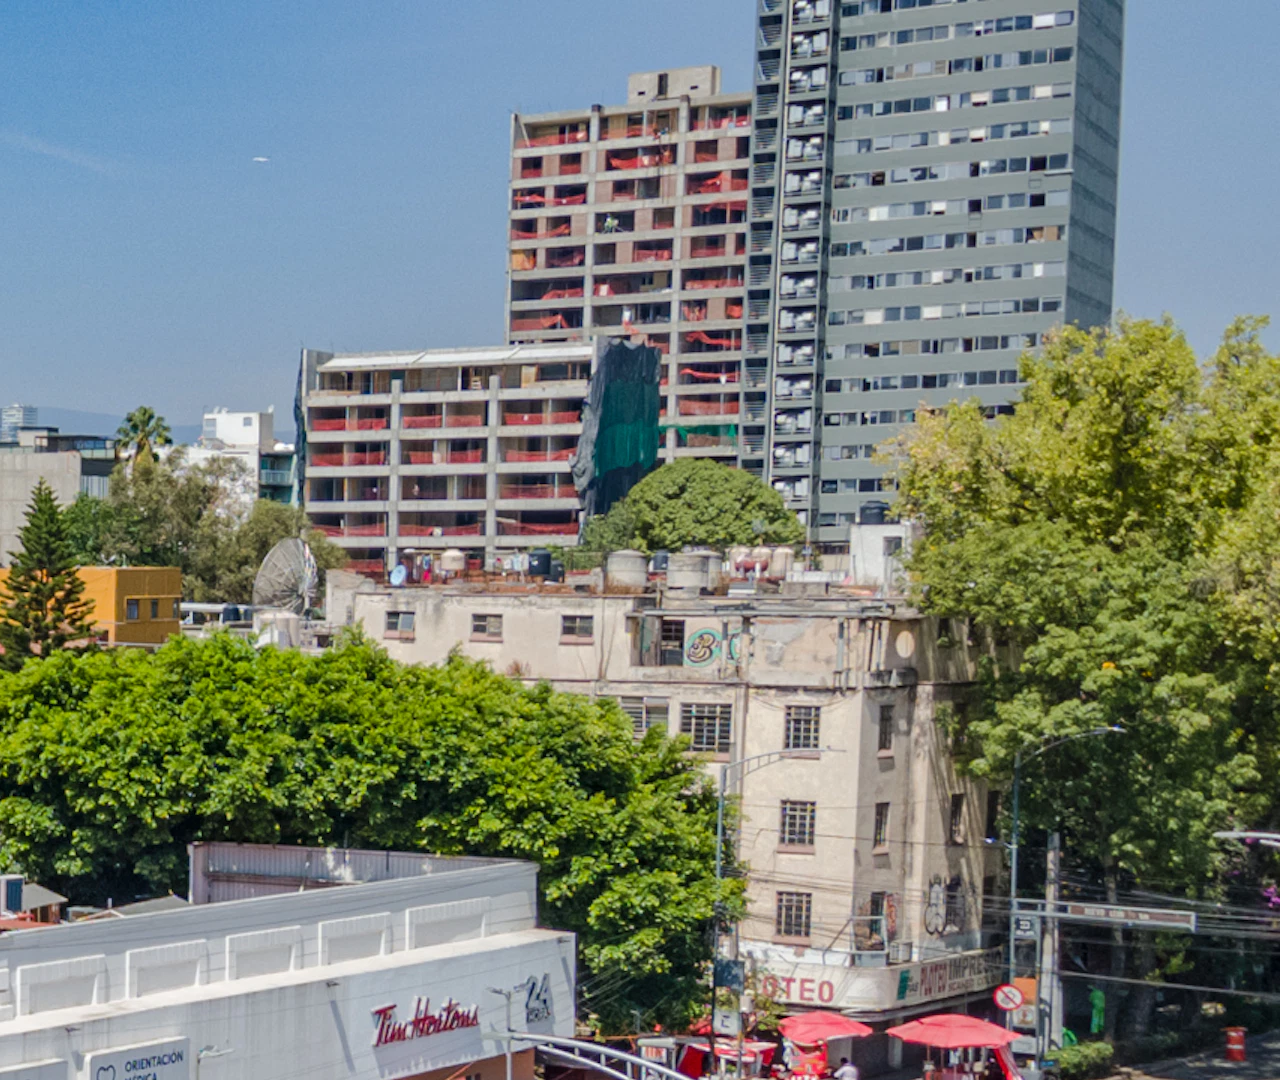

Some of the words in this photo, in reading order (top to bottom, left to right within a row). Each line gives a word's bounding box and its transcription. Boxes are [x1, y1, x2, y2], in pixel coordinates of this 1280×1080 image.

[761, 976, 835, 1002] OTEO
[372, 1003, 407, 1047] Tim
[407, 996, 480, 1039] Hortons
[124, 1049, 184, 1073] ORIENTACIÓN
